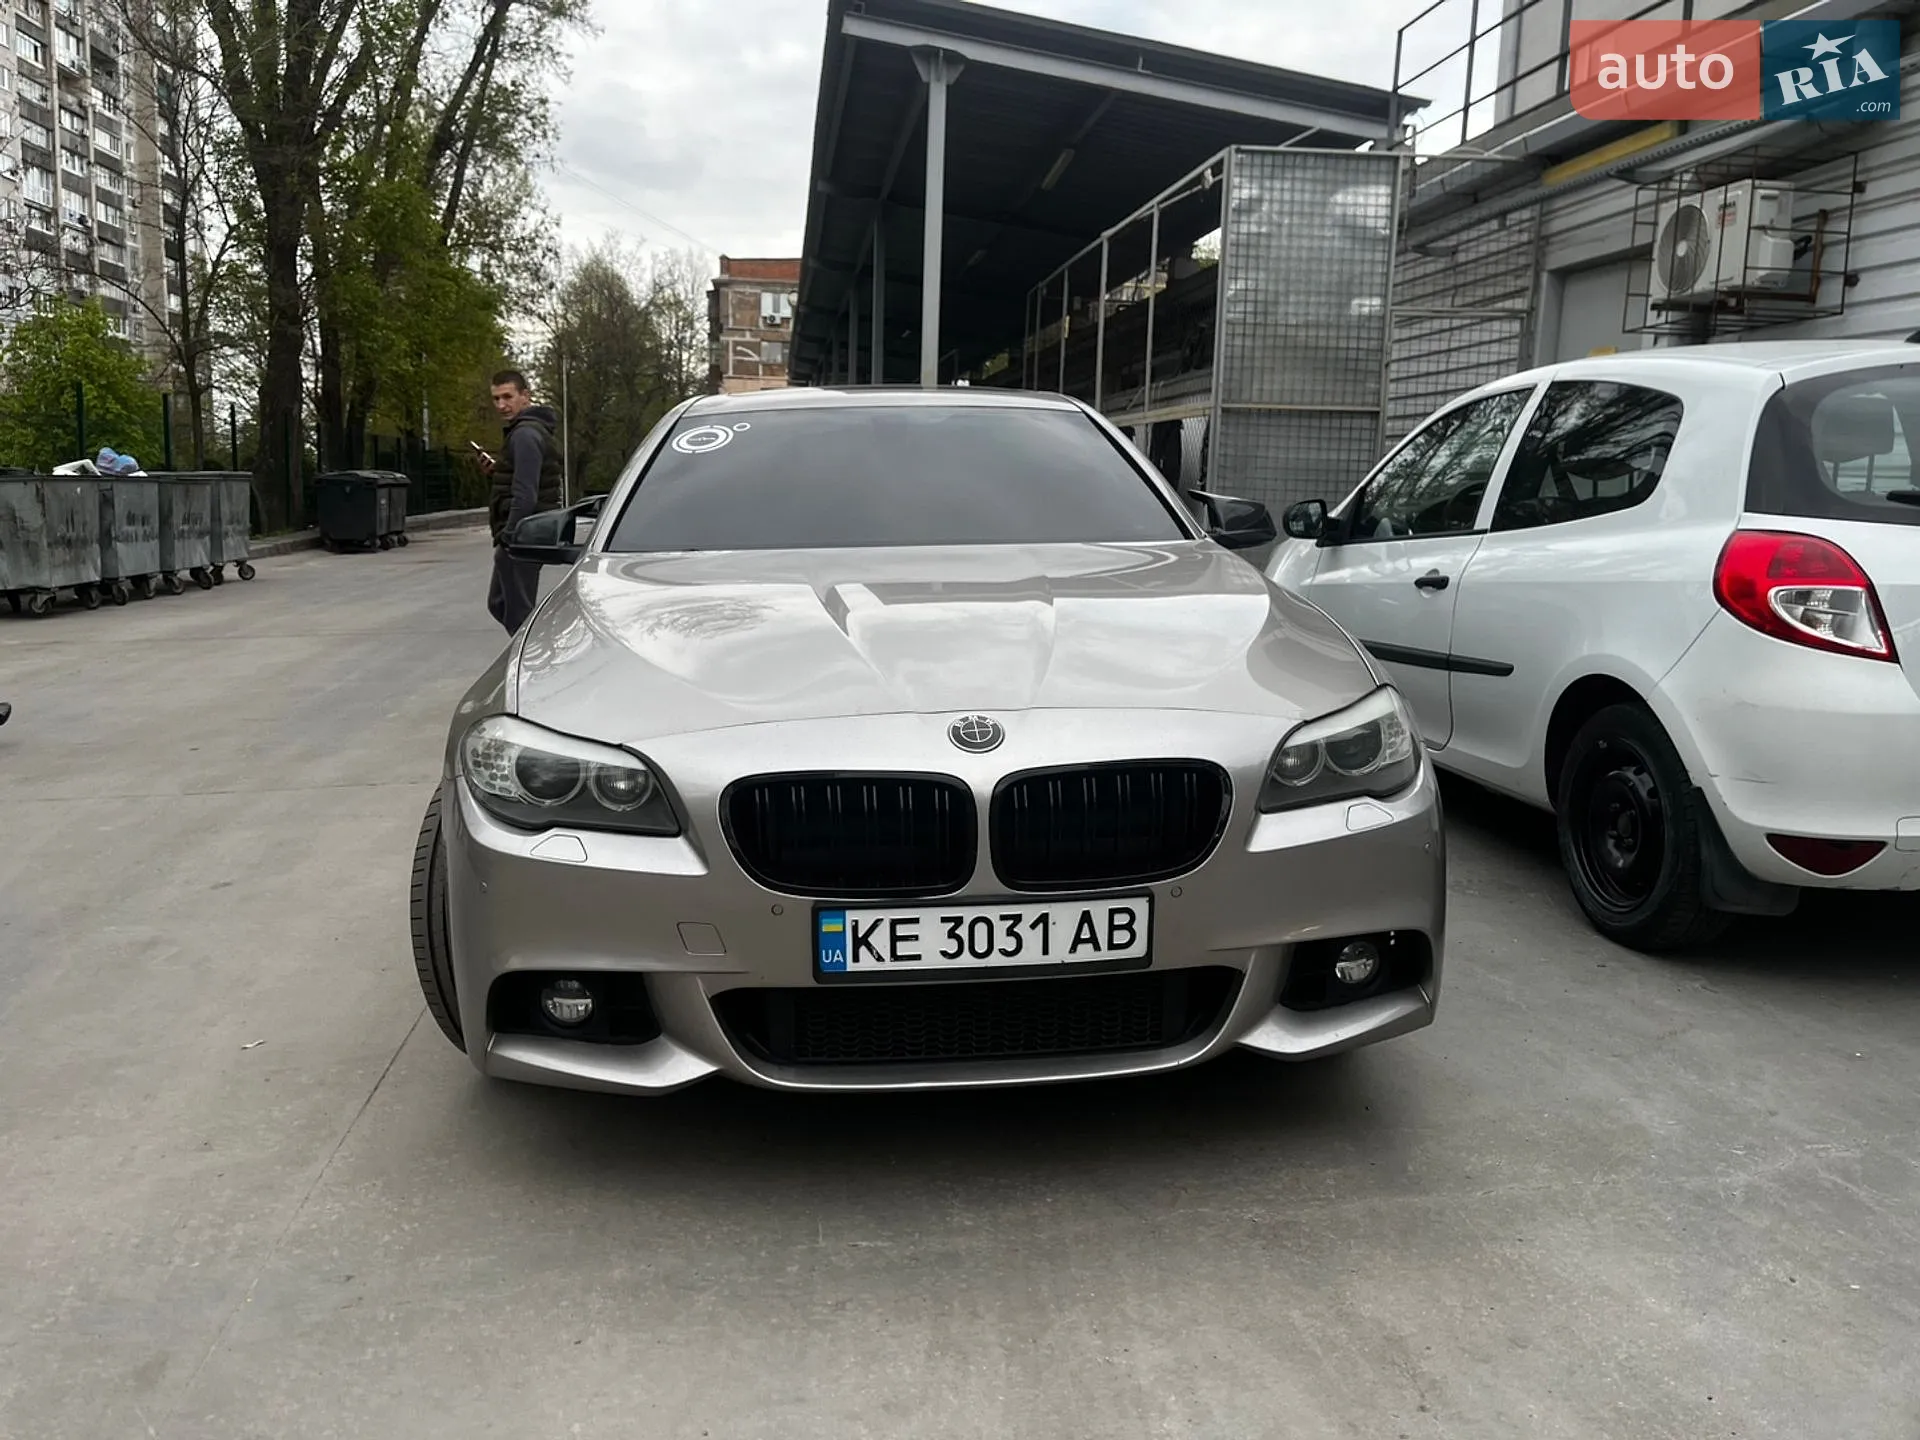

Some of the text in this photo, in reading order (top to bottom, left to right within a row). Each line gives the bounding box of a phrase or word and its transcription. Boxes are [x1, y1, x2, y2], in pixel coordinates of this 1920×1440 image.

[851, 906, 1138, 963] KE 3031 AB
[822, 950, 844, 964] UA
